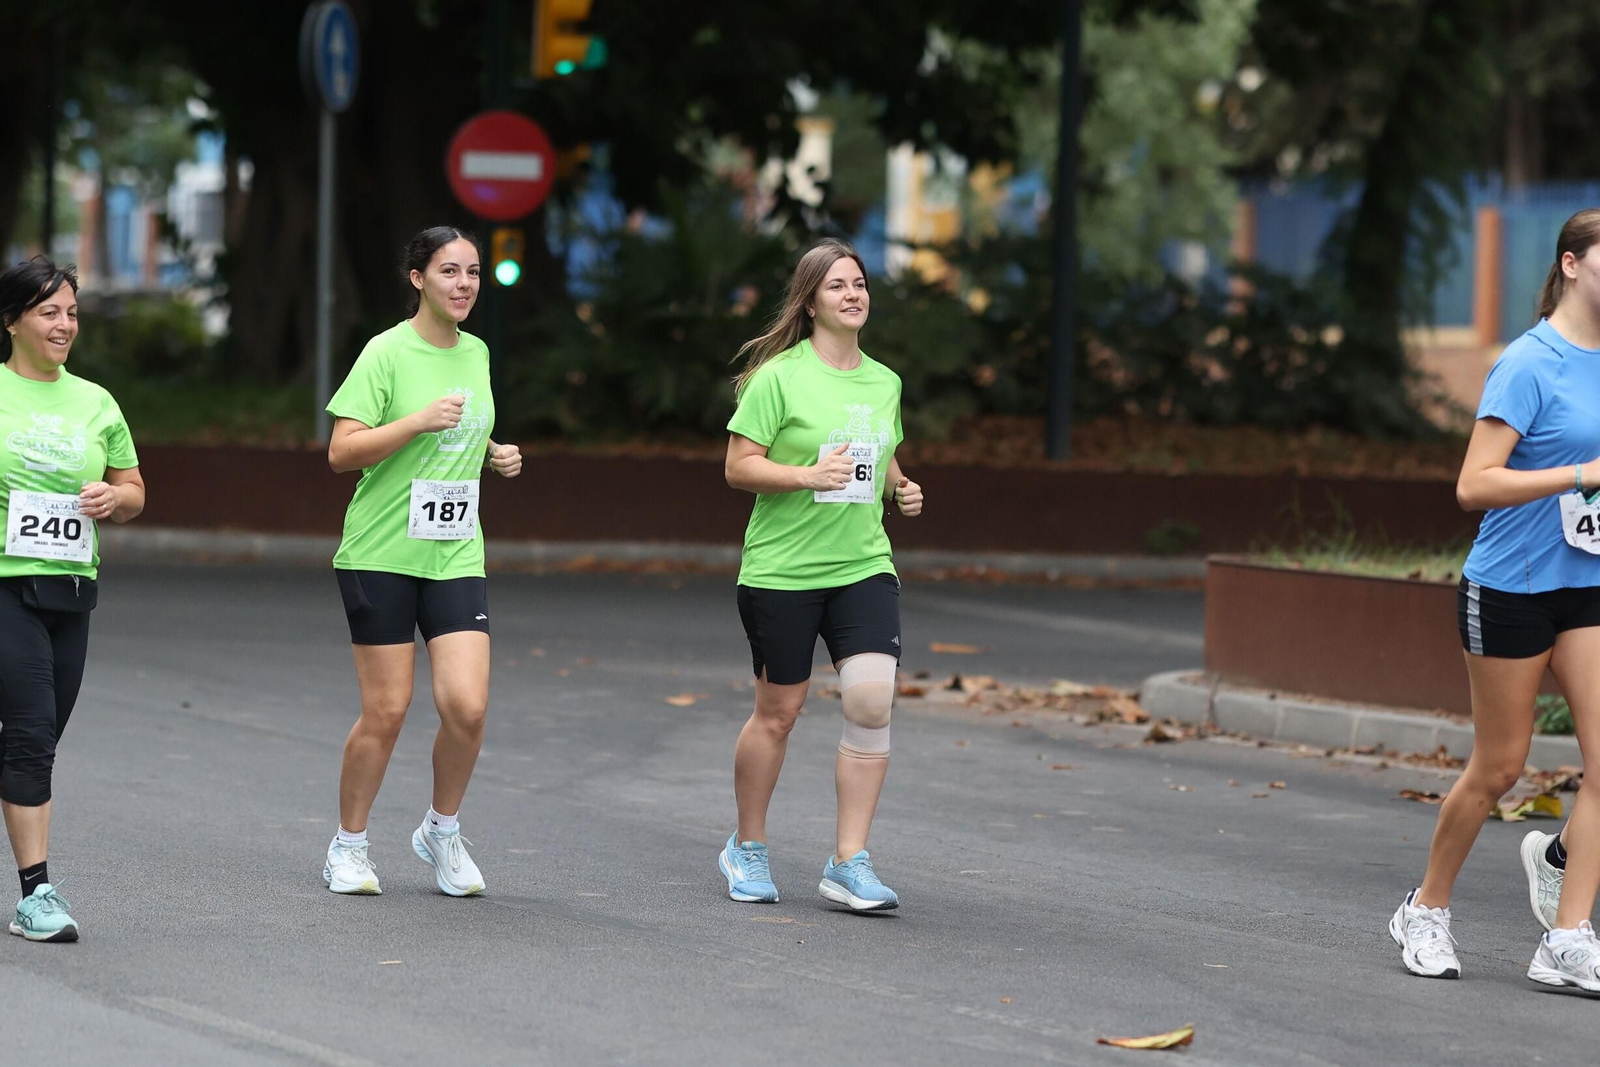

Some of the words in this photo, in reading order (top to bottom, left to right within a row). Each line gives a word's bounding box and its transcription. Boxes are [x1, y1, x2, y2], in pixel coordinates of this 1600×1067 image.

[421, 501, 469, 522] 187
[20, 514, 82, 541] 240
[1576, 513, 1600, 536] 4
